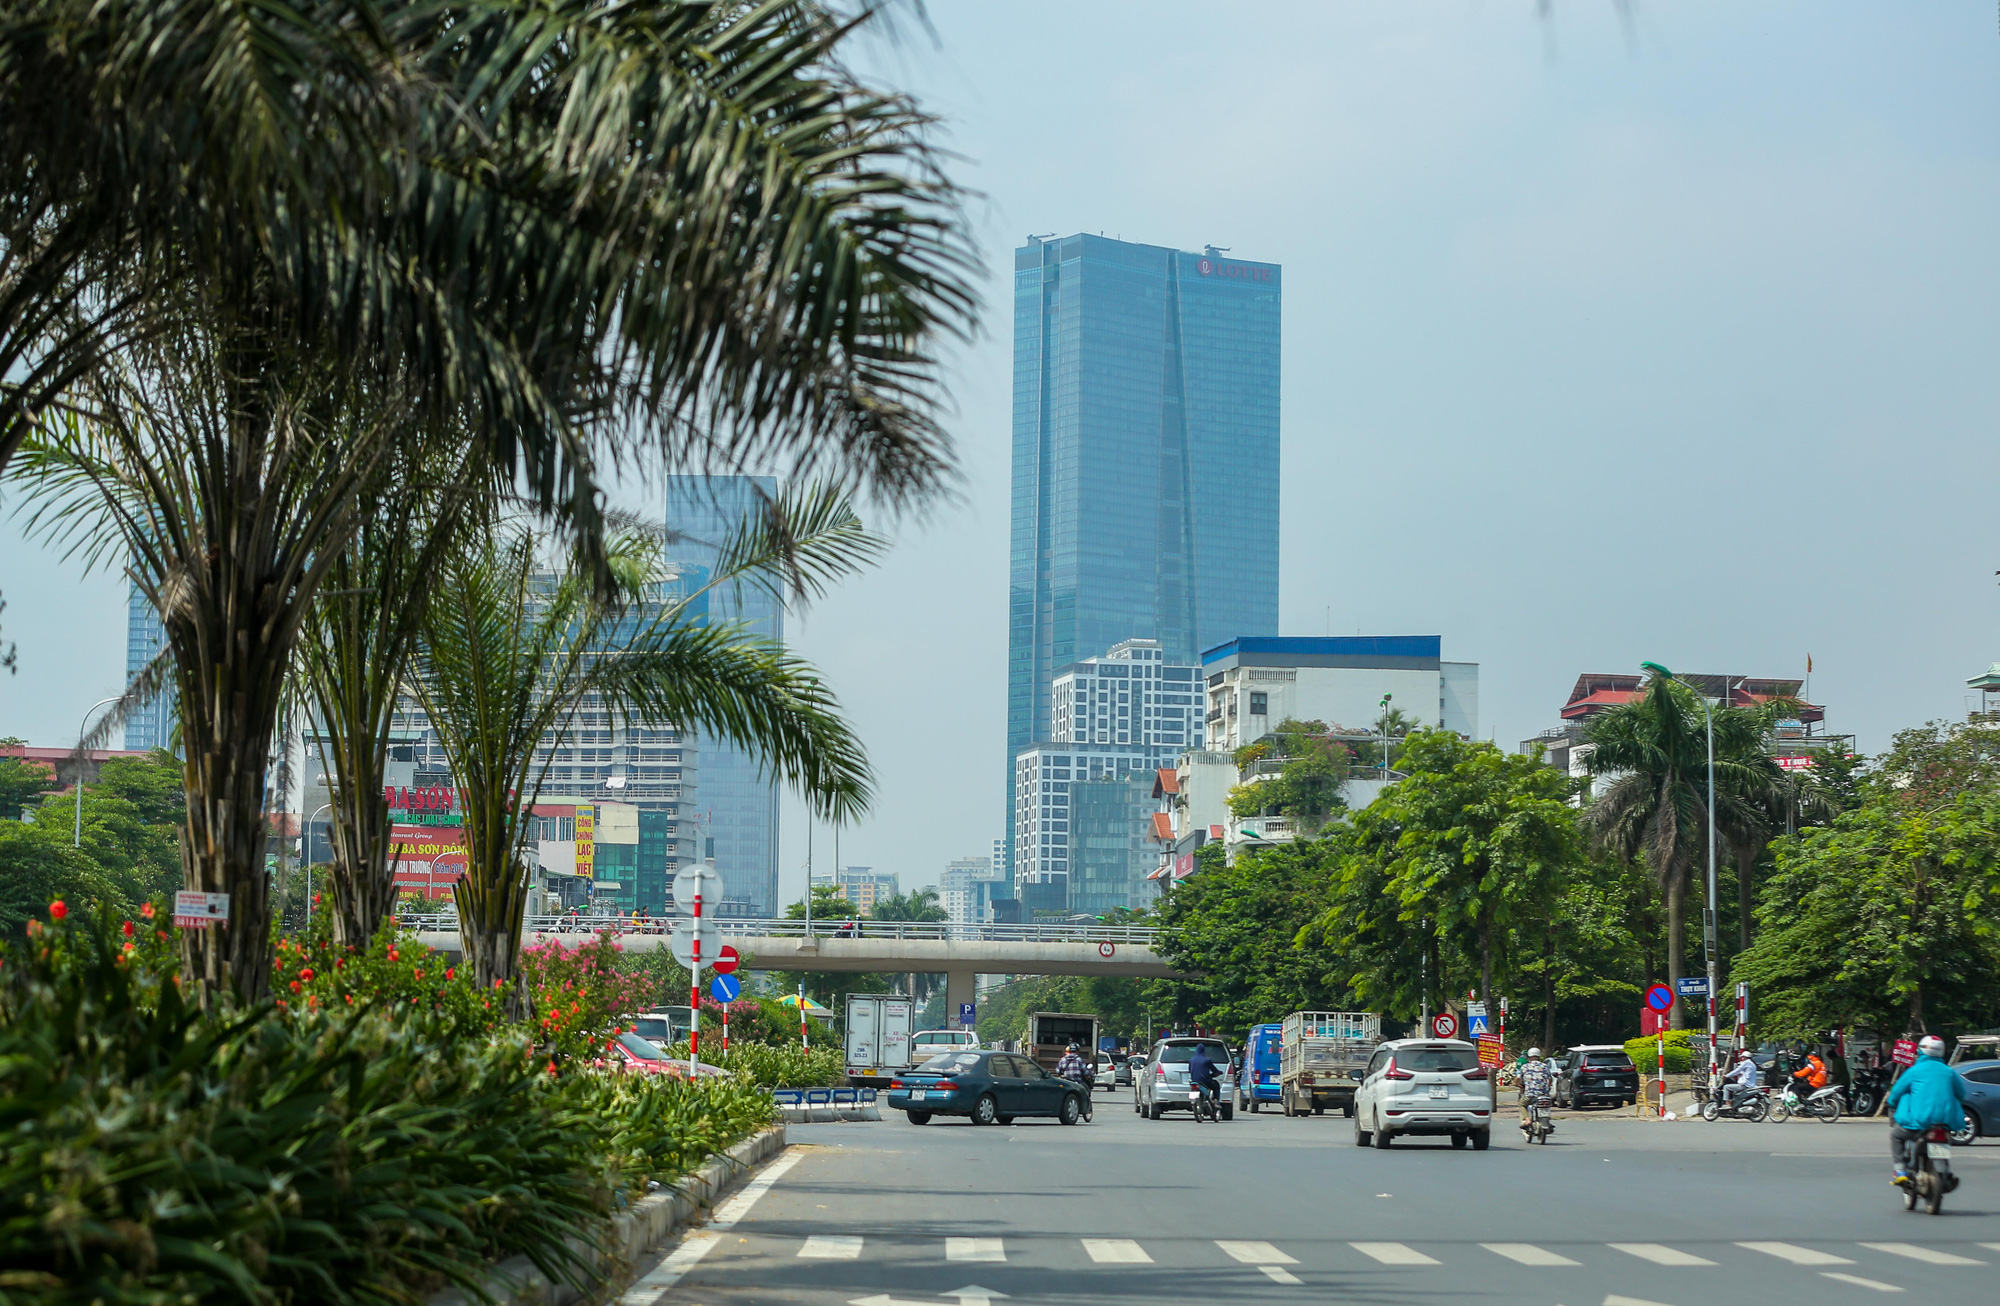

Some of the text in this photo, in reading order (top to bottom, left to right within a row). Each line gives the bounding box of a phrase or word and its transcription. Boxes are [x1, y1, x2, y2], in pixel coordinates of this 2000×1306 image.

[1216, 263, 1273, 281] LOTTE
[577, 817, 592, 828] CÔNG
[414, 831, 433, 840] Group
[577, 843, 591, 858] LẠC
[576, 860, 592, 877] VIỆT
[964, 1004, 972, 1014] P
